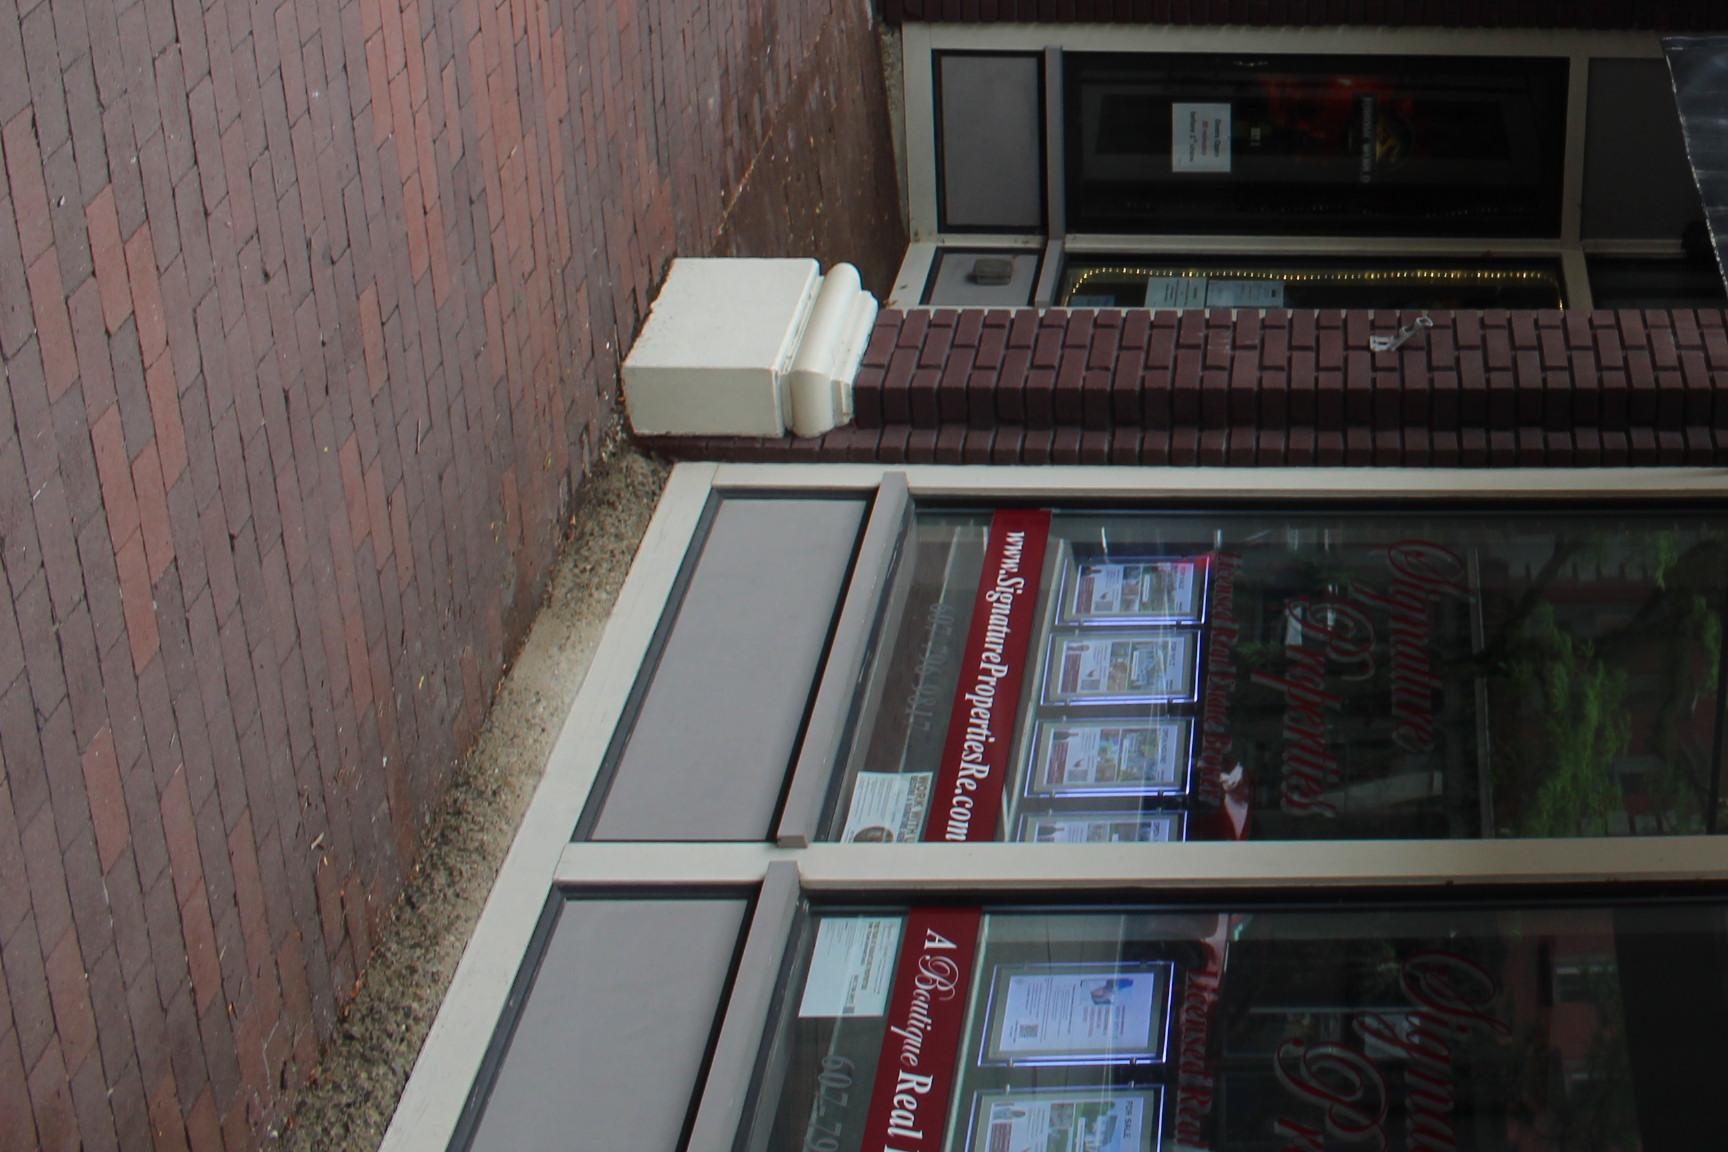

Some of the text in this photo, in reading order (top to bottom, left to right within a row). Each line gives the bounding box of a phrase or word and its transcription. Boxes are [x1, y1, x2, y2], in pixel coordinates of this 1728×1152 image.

[945, 529, 1026, 842] www.SignaturePropertiesRe.com
[1349, 540, 1477, 752] Signature
[1250, 597, 1375, 816] Properties
[914, 776, 929, 807] WORK
[922, 928, 958, 951] A
[889, 954, 960, 1068] Boutique
[1173, 969, 1219, 1149] Licensed Real
[887, 1068, 934, 1140] Real
[1123, 1100, 1134, 1139] FOR SALE
